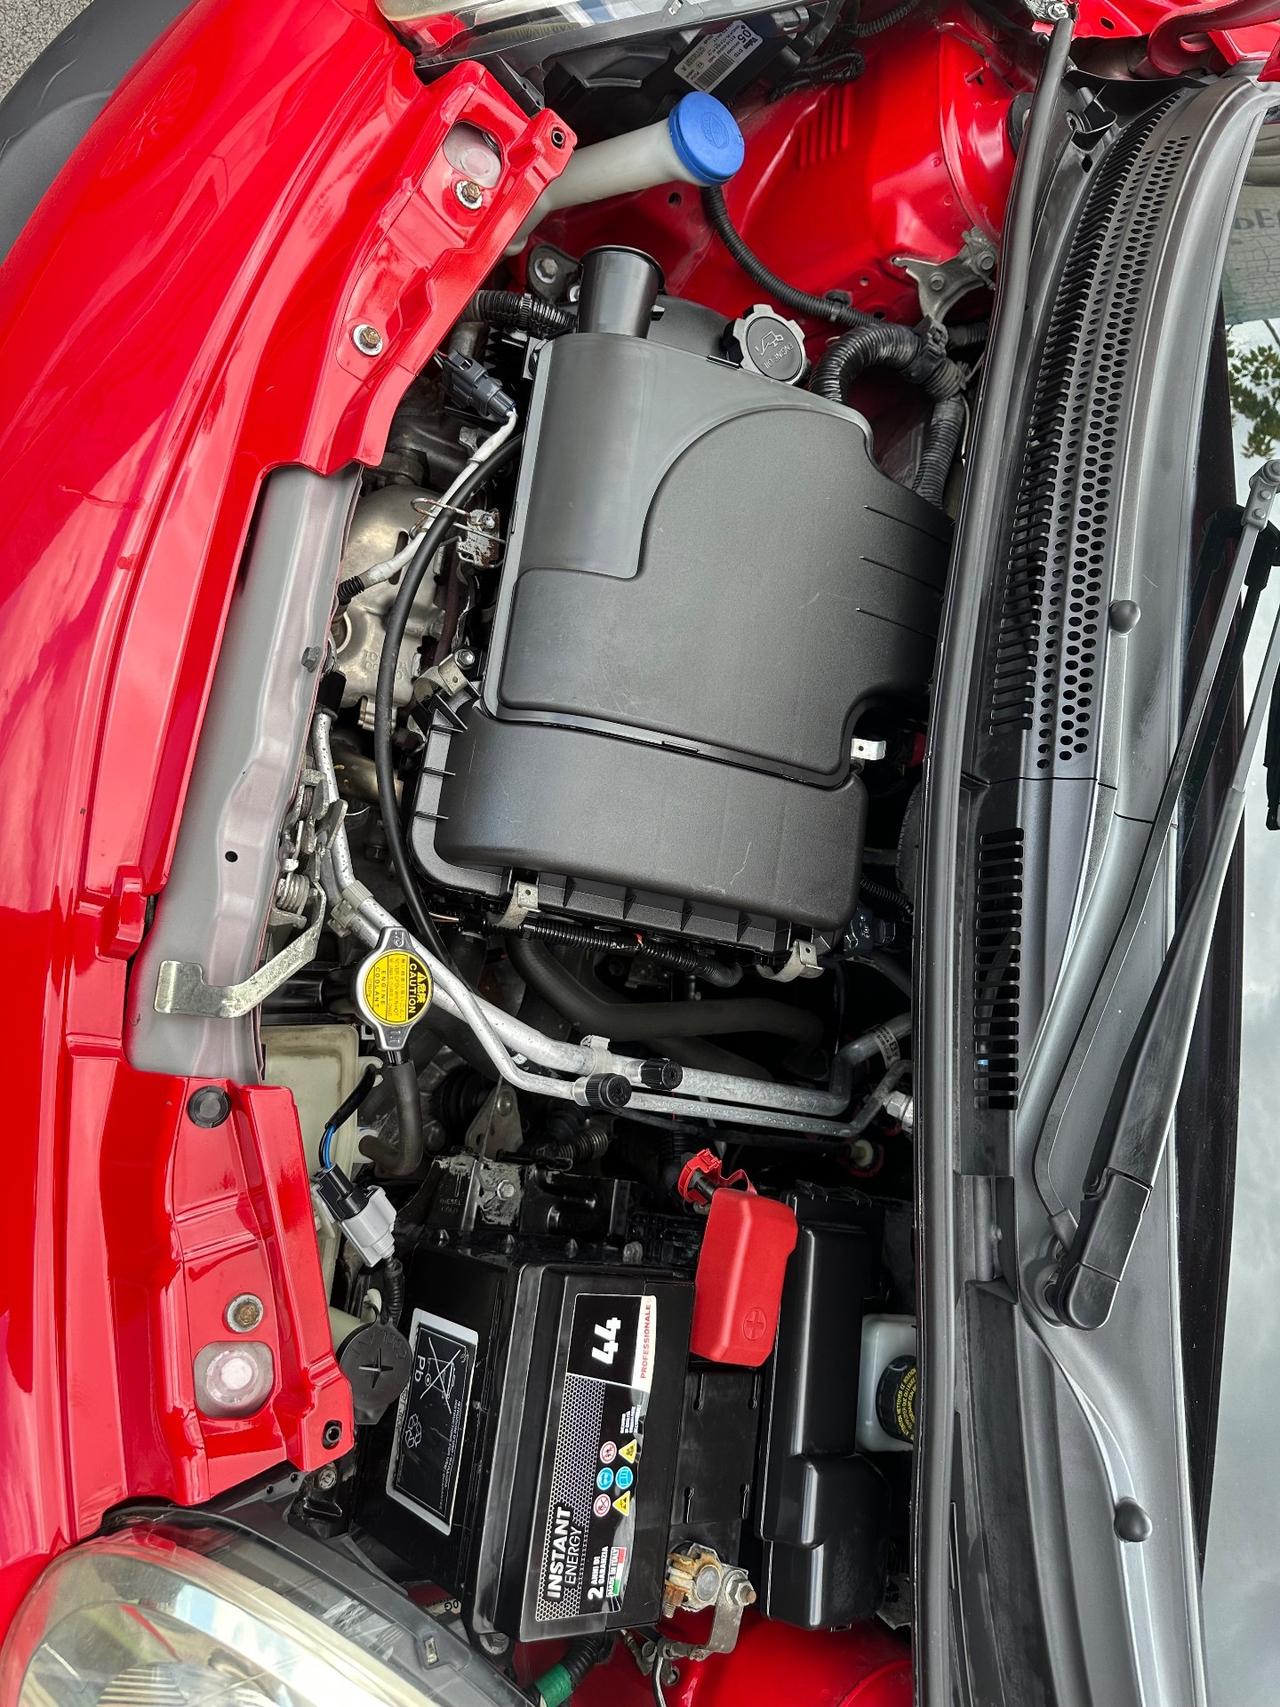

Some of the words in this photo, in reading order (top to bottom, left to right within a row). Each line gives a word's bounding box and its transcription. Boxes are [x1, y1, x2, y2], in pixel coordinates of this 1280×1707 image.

[737, 28, 752, 43] 05
[409, 963, 417, 1014] CAUTION
[591, 1317, 622, 1365] 44
[640, 1304, 651, 1379] PROFESSIONALE
[414, 1355, 426, 1382] Pb
[547, 1506, 571, 1599] INSTANT
[565, 1526, 582, 1585] ENERGY
[593, 1555, 600, 1565] DI
[611, 1548, 619, 1567] ITALY
[591, 1566, 600, 1585] ANNI
[598, 1546, 609, 1585] GARANZIA
[609, 1567, 616, 1576] IN
[588, 1586, 604, 1600] 2
[607, 1575, 615, 1596] MADE
